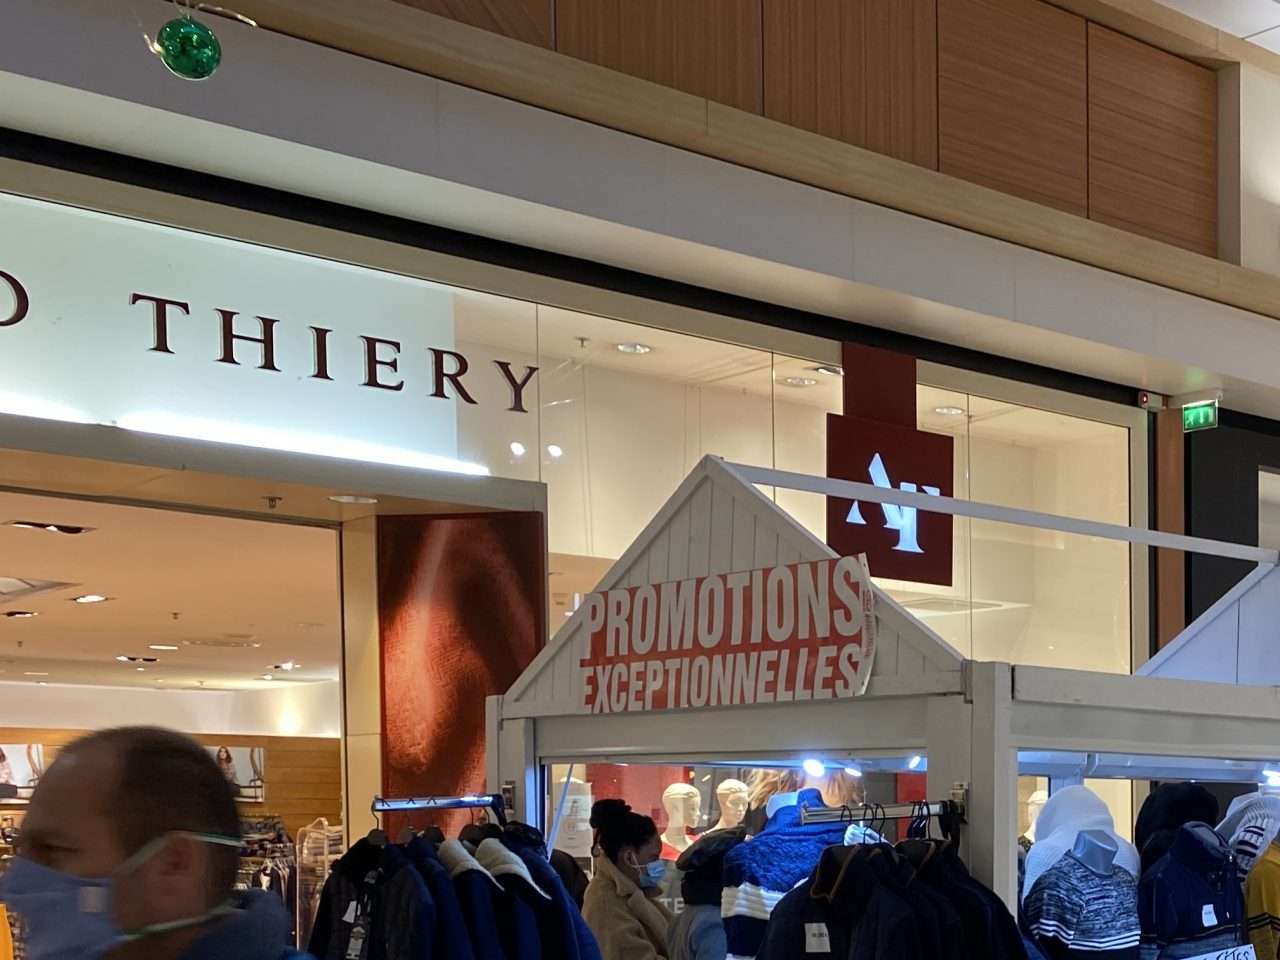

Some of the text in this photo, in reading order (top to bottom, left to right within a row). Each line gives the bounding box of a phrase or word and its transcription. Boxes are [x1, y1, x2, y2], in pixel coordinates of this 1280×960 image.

[130, 293, 539, 414] THIERY
[583, 555, 864, 660] PROMOTIONS
[580, 643, 862, 714] EXCEPTIONNELLES
